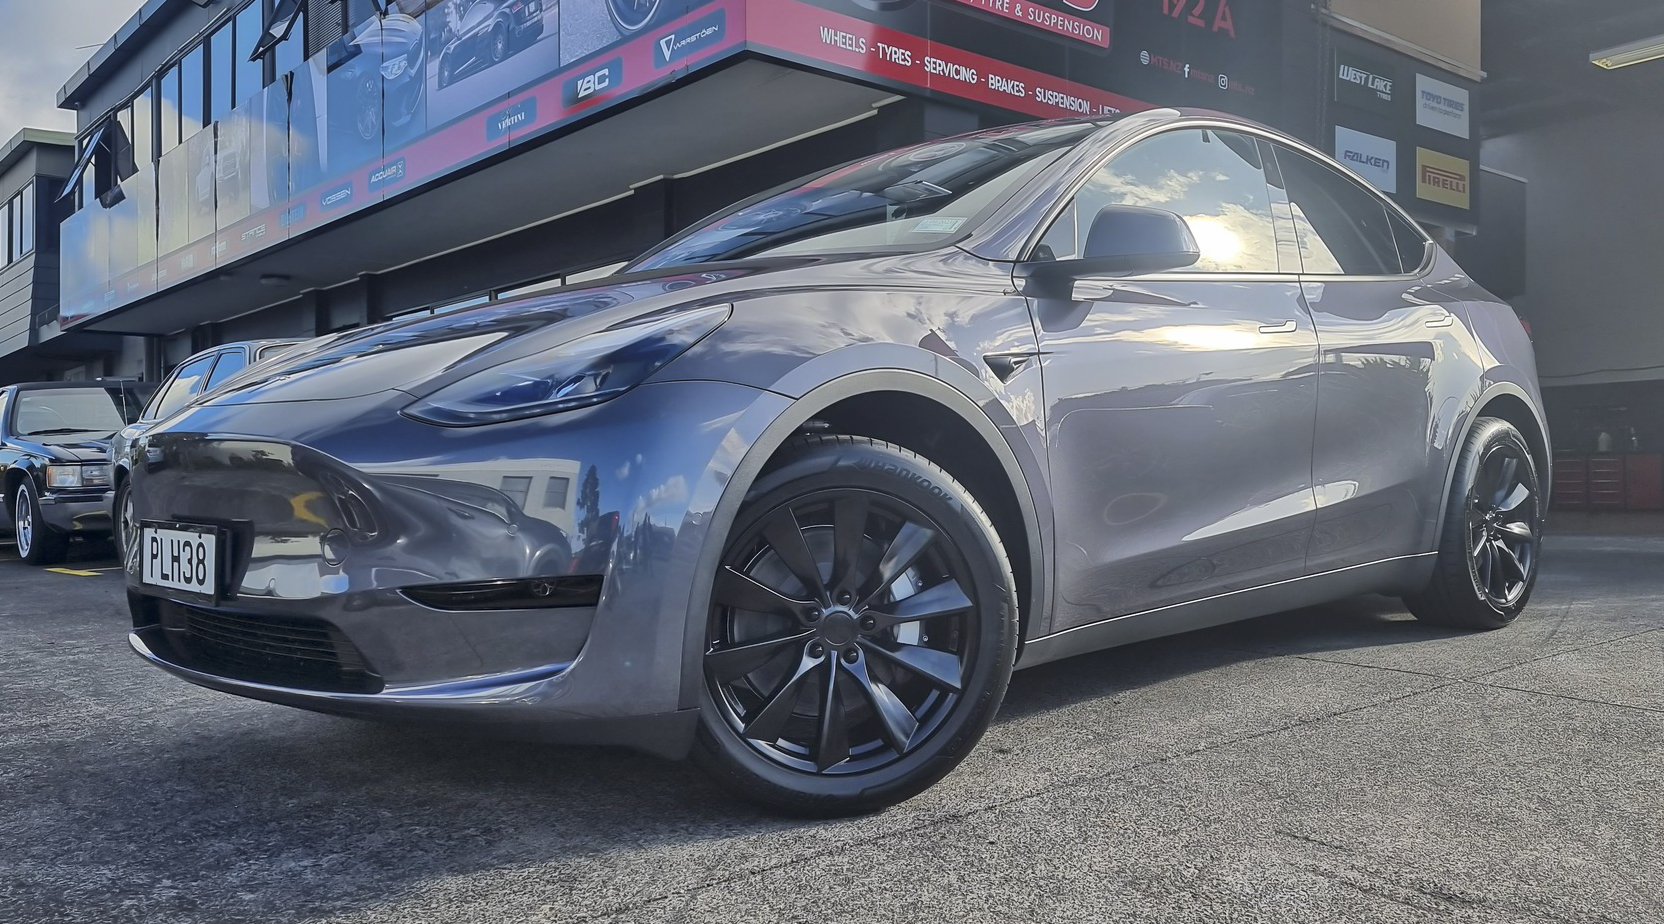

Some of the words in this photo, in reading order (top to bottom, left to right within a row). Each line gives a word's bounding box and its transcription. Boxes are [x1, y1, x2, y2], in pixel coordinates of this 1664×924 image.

[1015, 3, 1023, 16] &
[1028, 7, 1102, 41] SUSPENSION
[820, 26, 866, 54] WHEELS
[877, 42, 912, 67] TYRES
[924, 56, 977, 85] SERVICING
[988, 74, 1025, 97] BRAKES
[1035, 87, 1090, 115] SUSPENSION
[1339, 64, 1367, 86] WEST
[1367, 74, 1393, 94] LAKE
[1421, 90, 1442, 105] TOYO
[1442, 97, 1465, 112] TIRES
[1343, 150, 1390, 170] FALKEN
[1421, 165, 1466, 194] PIRELLI
[150, 536, 206, 587] PLH38
